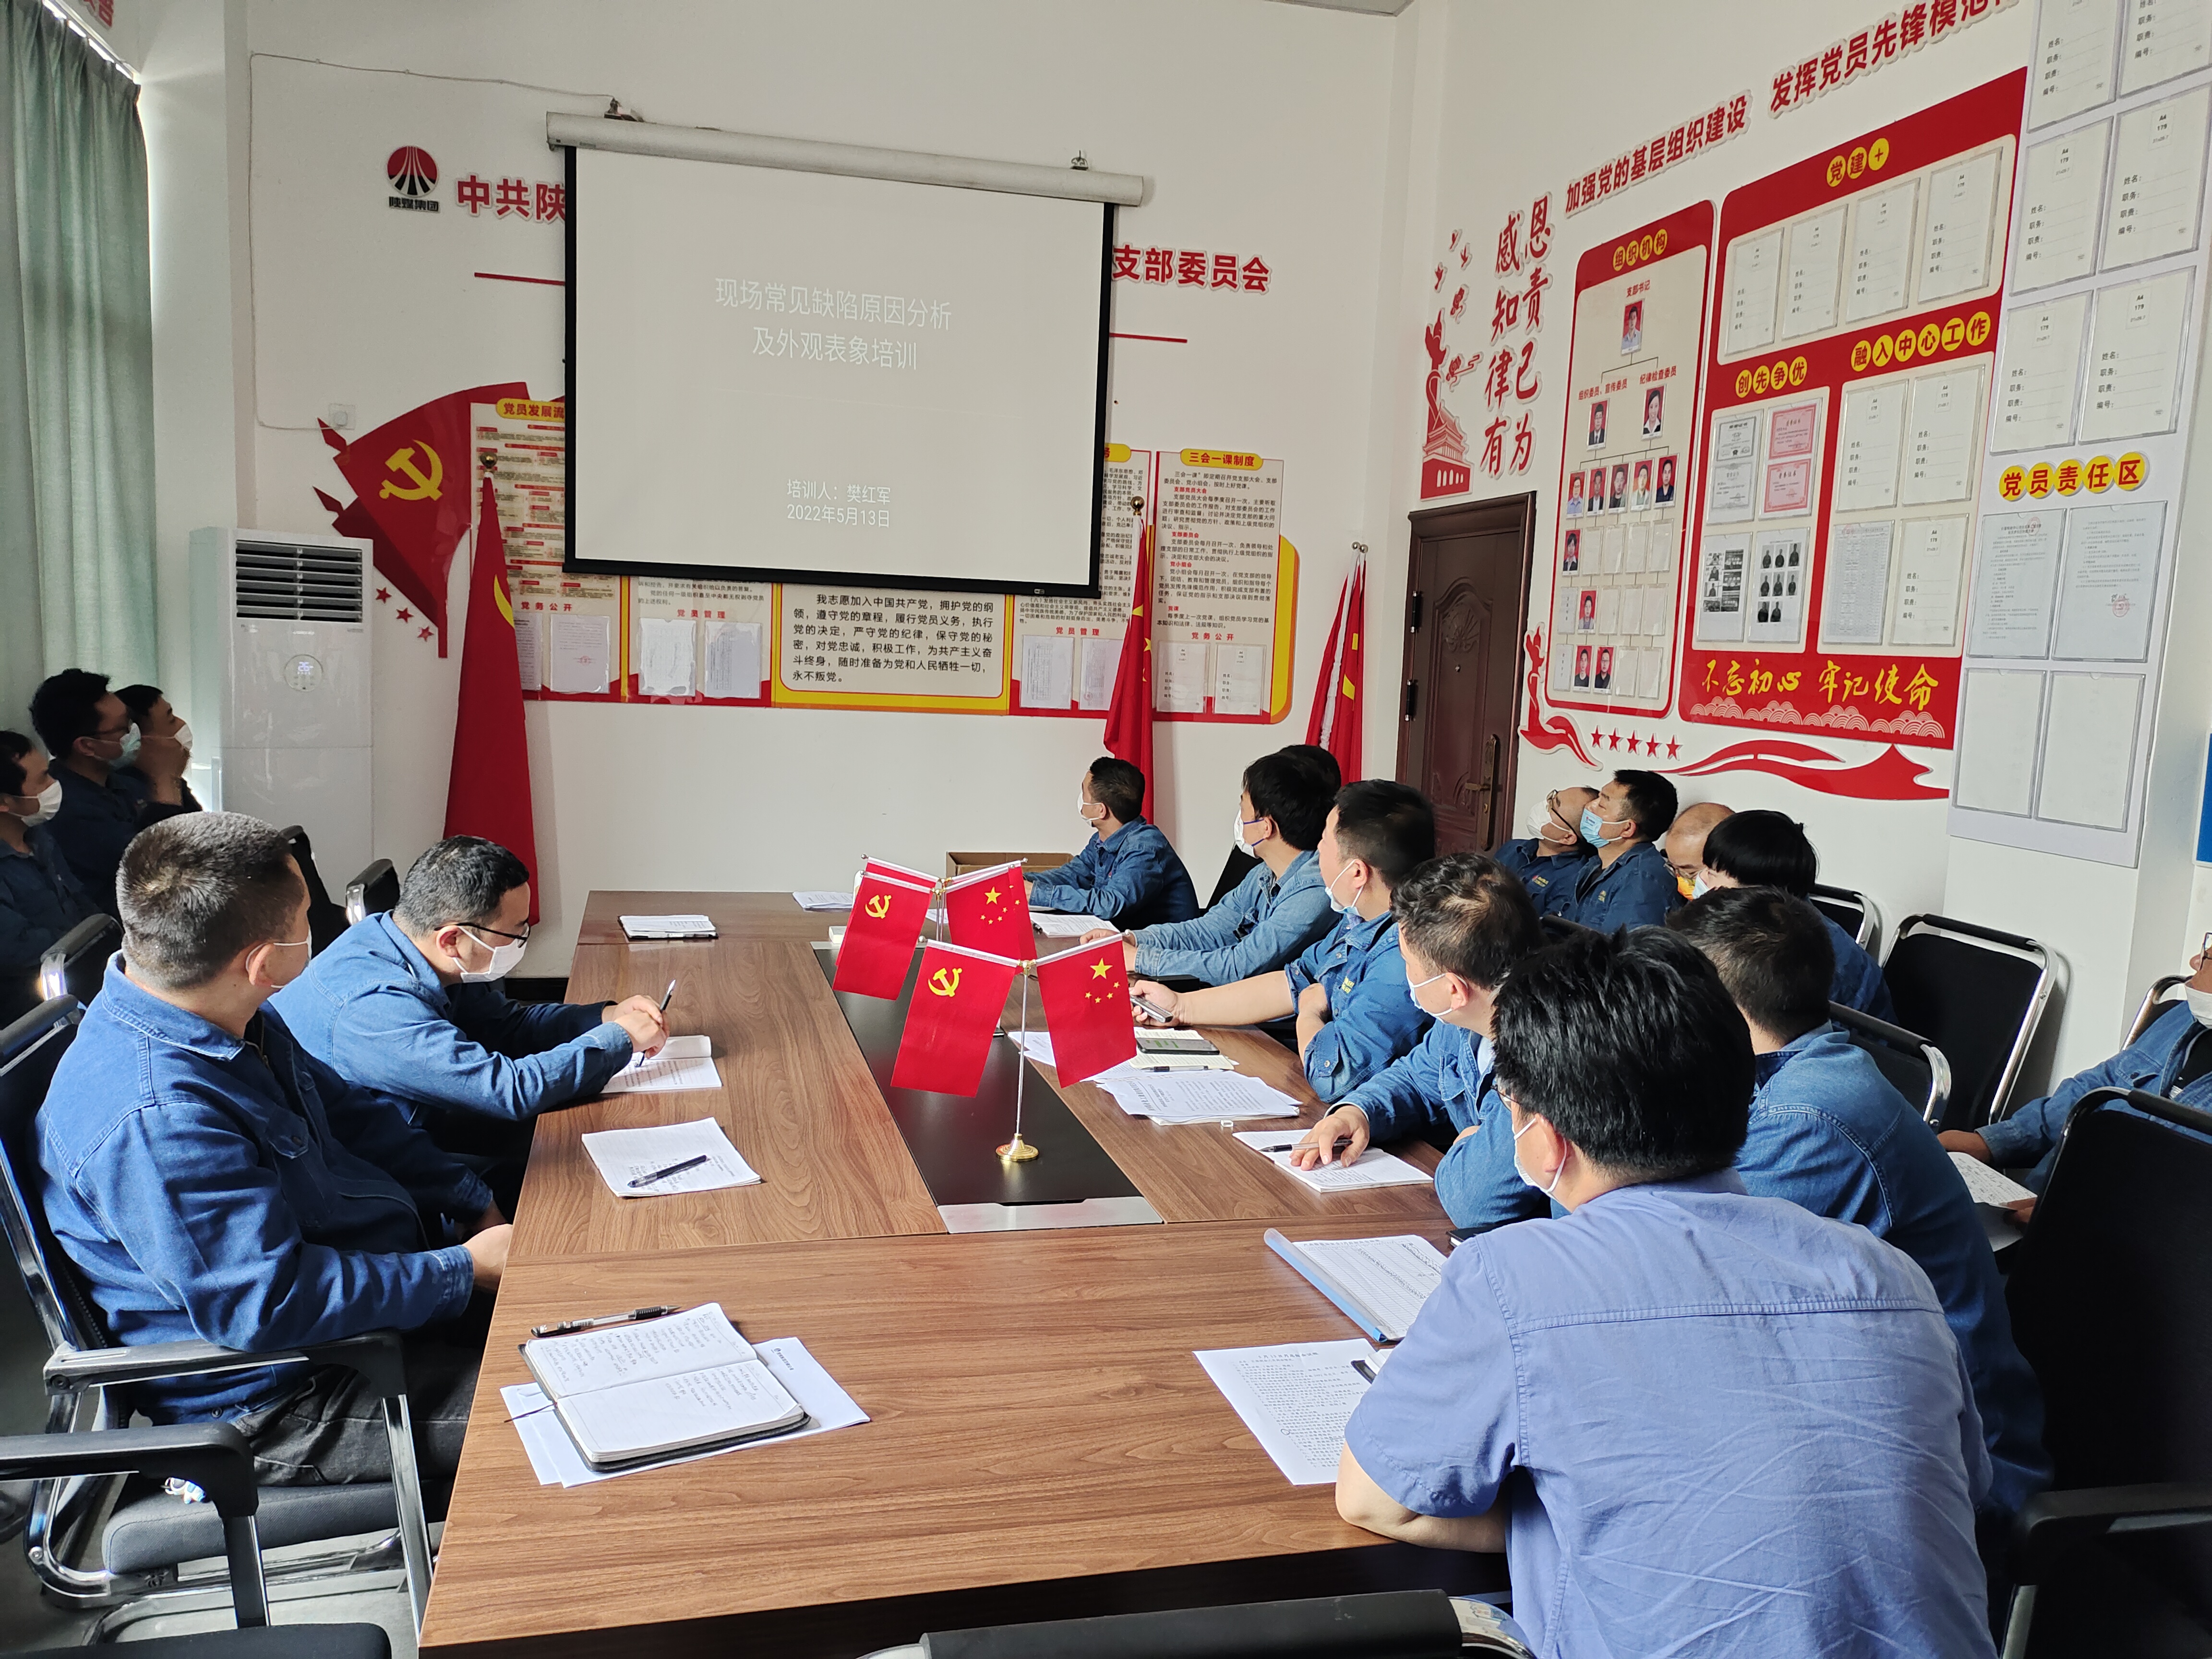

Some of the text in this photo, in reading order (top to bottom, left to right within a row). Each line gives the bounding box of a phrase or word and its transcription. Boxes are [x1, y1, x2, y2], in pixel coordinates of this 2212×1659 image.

[1770, 0, 2001, 112] 发挥党员先锋模范
[1565, 95, 1746, 214] 加强党的基层组织建设
[1830, 148, 1885, 184] 党建+
[389, 196, 439, 212] 陕煤集团
[457, 175, 565, 221] 中共陕
[1495, 195, 1551, 272] 感恩
[1615, 232, 1666, 267] 组织机构
[1112, 244, 1269, 292] 支部委员会
[715, 277, 952, 331] 现场常见缺陷原因分析
[1491, 267, 1548, 343] 知责
[1626, 279, 1650, 298] 支部书记
[752, 326, 917, 370] 及外观表象培训
[1853, 317, 1988, 366] 融入中心工作
[1485, 340, 1538, 408] 律己
[1639, 366, 1677, 385] 纪律检查委员
[1738, 360, 1806, 394] 创先争优
[1189, 452, 1255, 467] 三会一课制度
[1479, 412, 1532, 476] 有为
[2003, 459, 2140, 497] 党员责任区
[787, 504, 890, 529] 2022年5月13日
[793, 608, 993, 628] 领，遵守党的章程，履行党员义务，执行
[817, 594, 993, 613] 我志愿加入中国共产党，拥护党的纲
[793, 624, 993, 643] 党的决定，严守党的纪律，保守党的秘
[793, 639, 992, 658] 密，对党忠诚，积极工作，为共产主义奋
[1191, 632, 1234, 641] 党务公开
[792, 671, 843, 682] 永不叛党。
[793, 656, 986, 673] 斗终身，随时准备为党和人民牺牲一切，
[1702, 659, 1939, 711] 不忘初心 牢记使命
